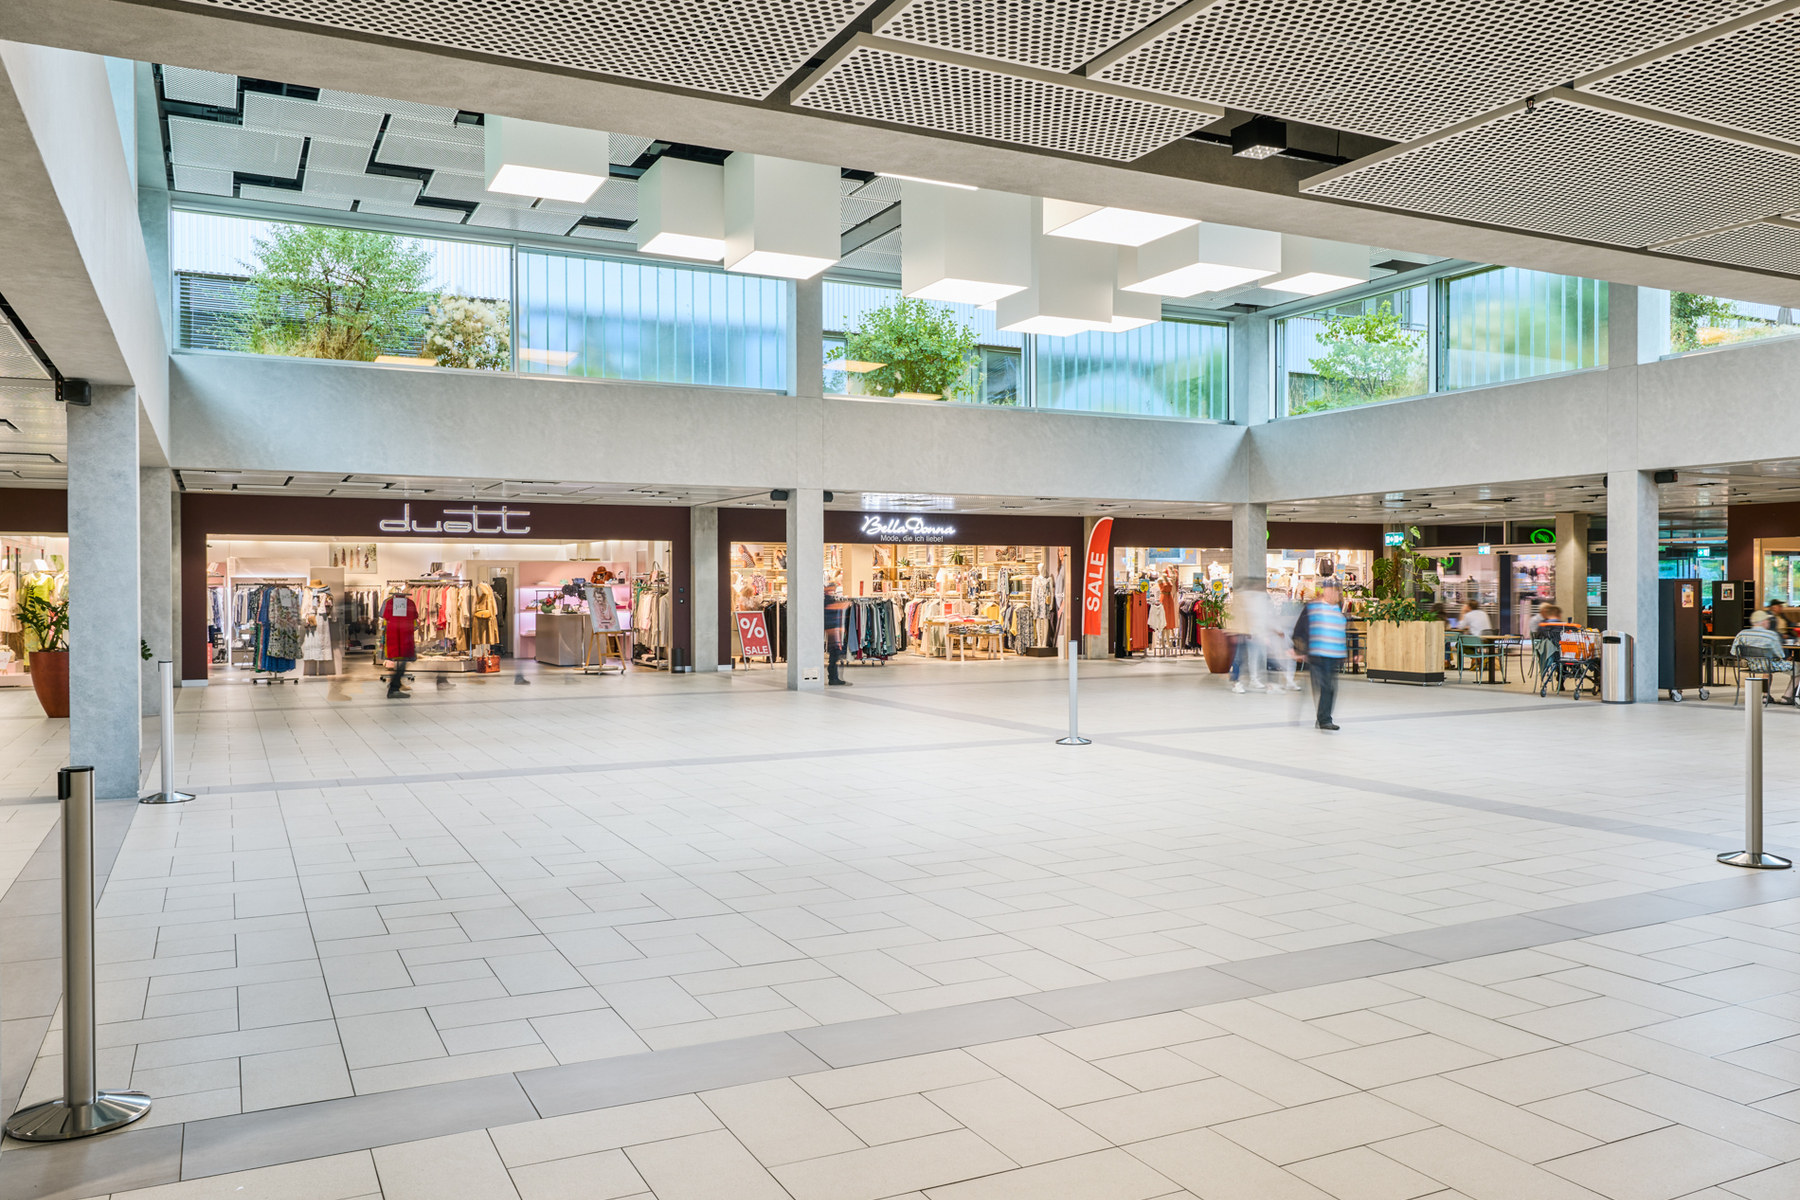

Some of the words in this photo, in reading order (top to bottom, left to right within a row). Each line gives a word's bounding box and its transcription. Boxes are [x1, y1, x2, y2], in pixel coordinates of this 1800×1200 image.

[861, 516, 908, 535] Bella
[905, 517, 956, 534] Donna
[880, 534, 901, 542] Mode,
[902, 534, 913, 542] die
[914, 534, 925, 542] ich
[925, 535, 944, 543] liebe!
[1086, 552, 1105, 612] SALE
[739, 617, 765, 639] %
[745, 645, 769, 655] SALE
